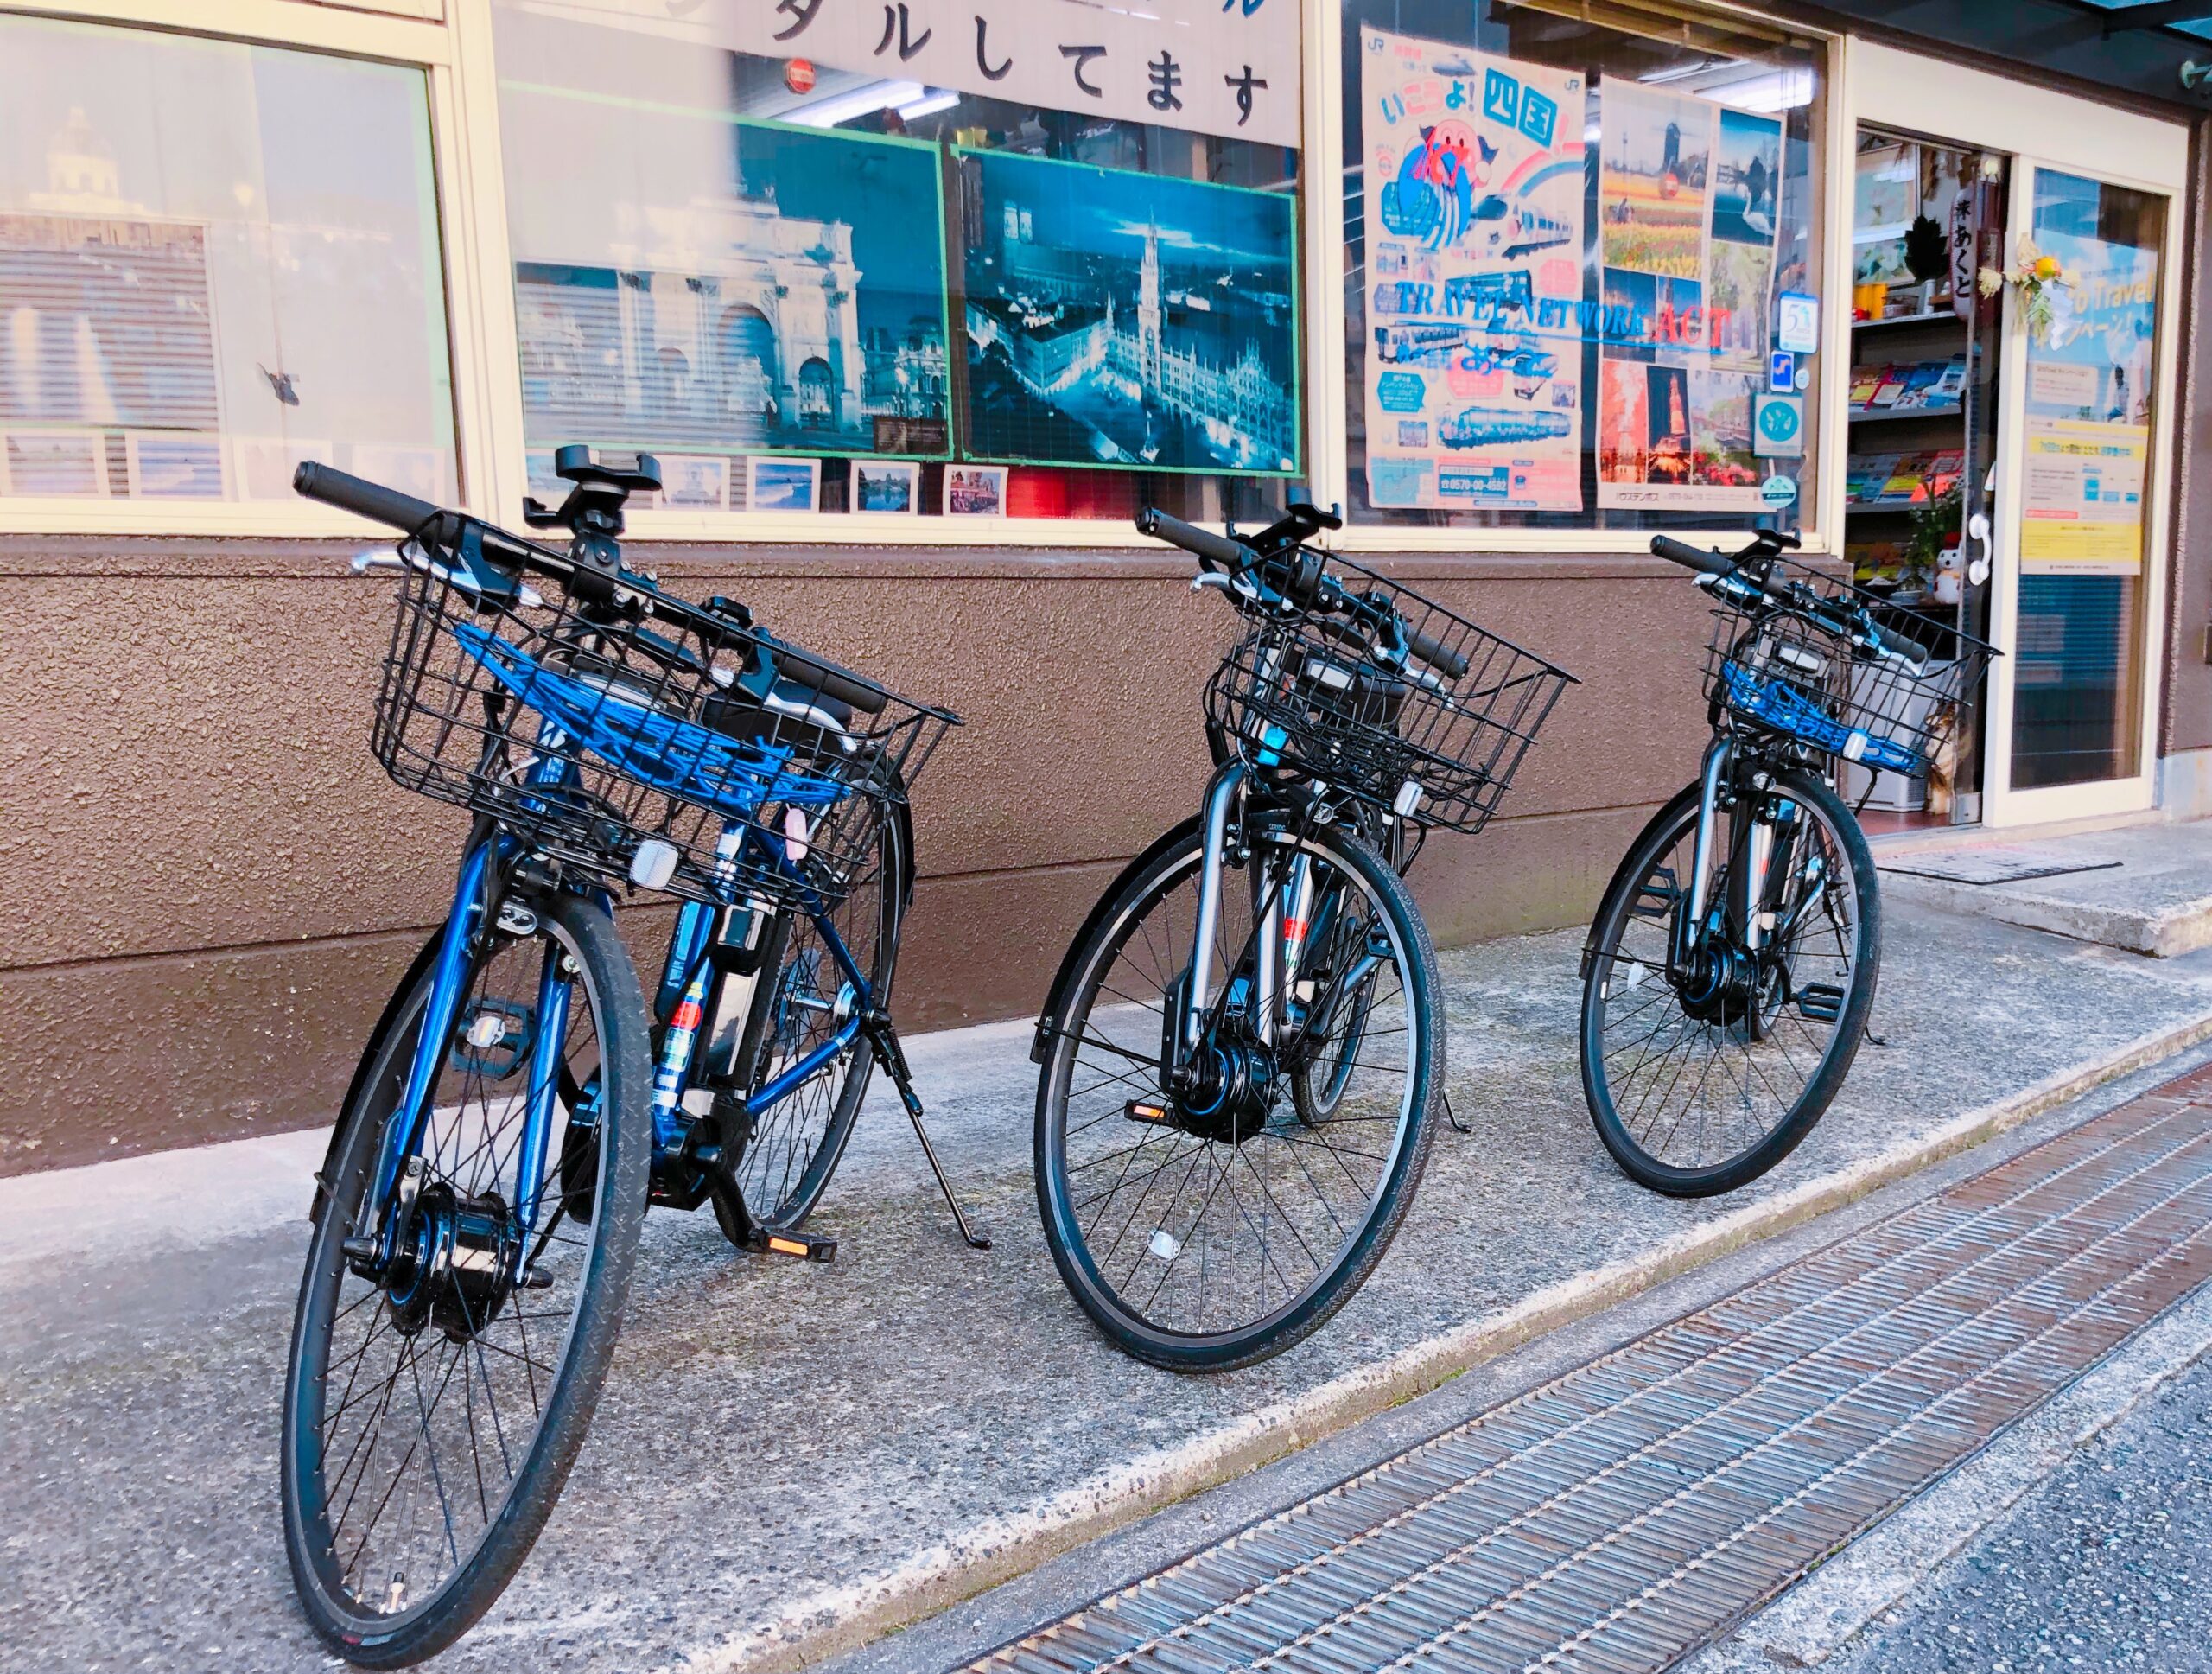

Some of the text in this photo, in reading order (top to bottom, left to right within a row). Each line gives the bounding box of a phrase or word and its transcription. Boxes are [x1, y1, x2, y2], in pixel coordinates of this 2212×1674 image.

[665, 0, 1269, 127] タルしてます
[1396, 280, 1732, 348] TRAVEL NETWORK ACT
